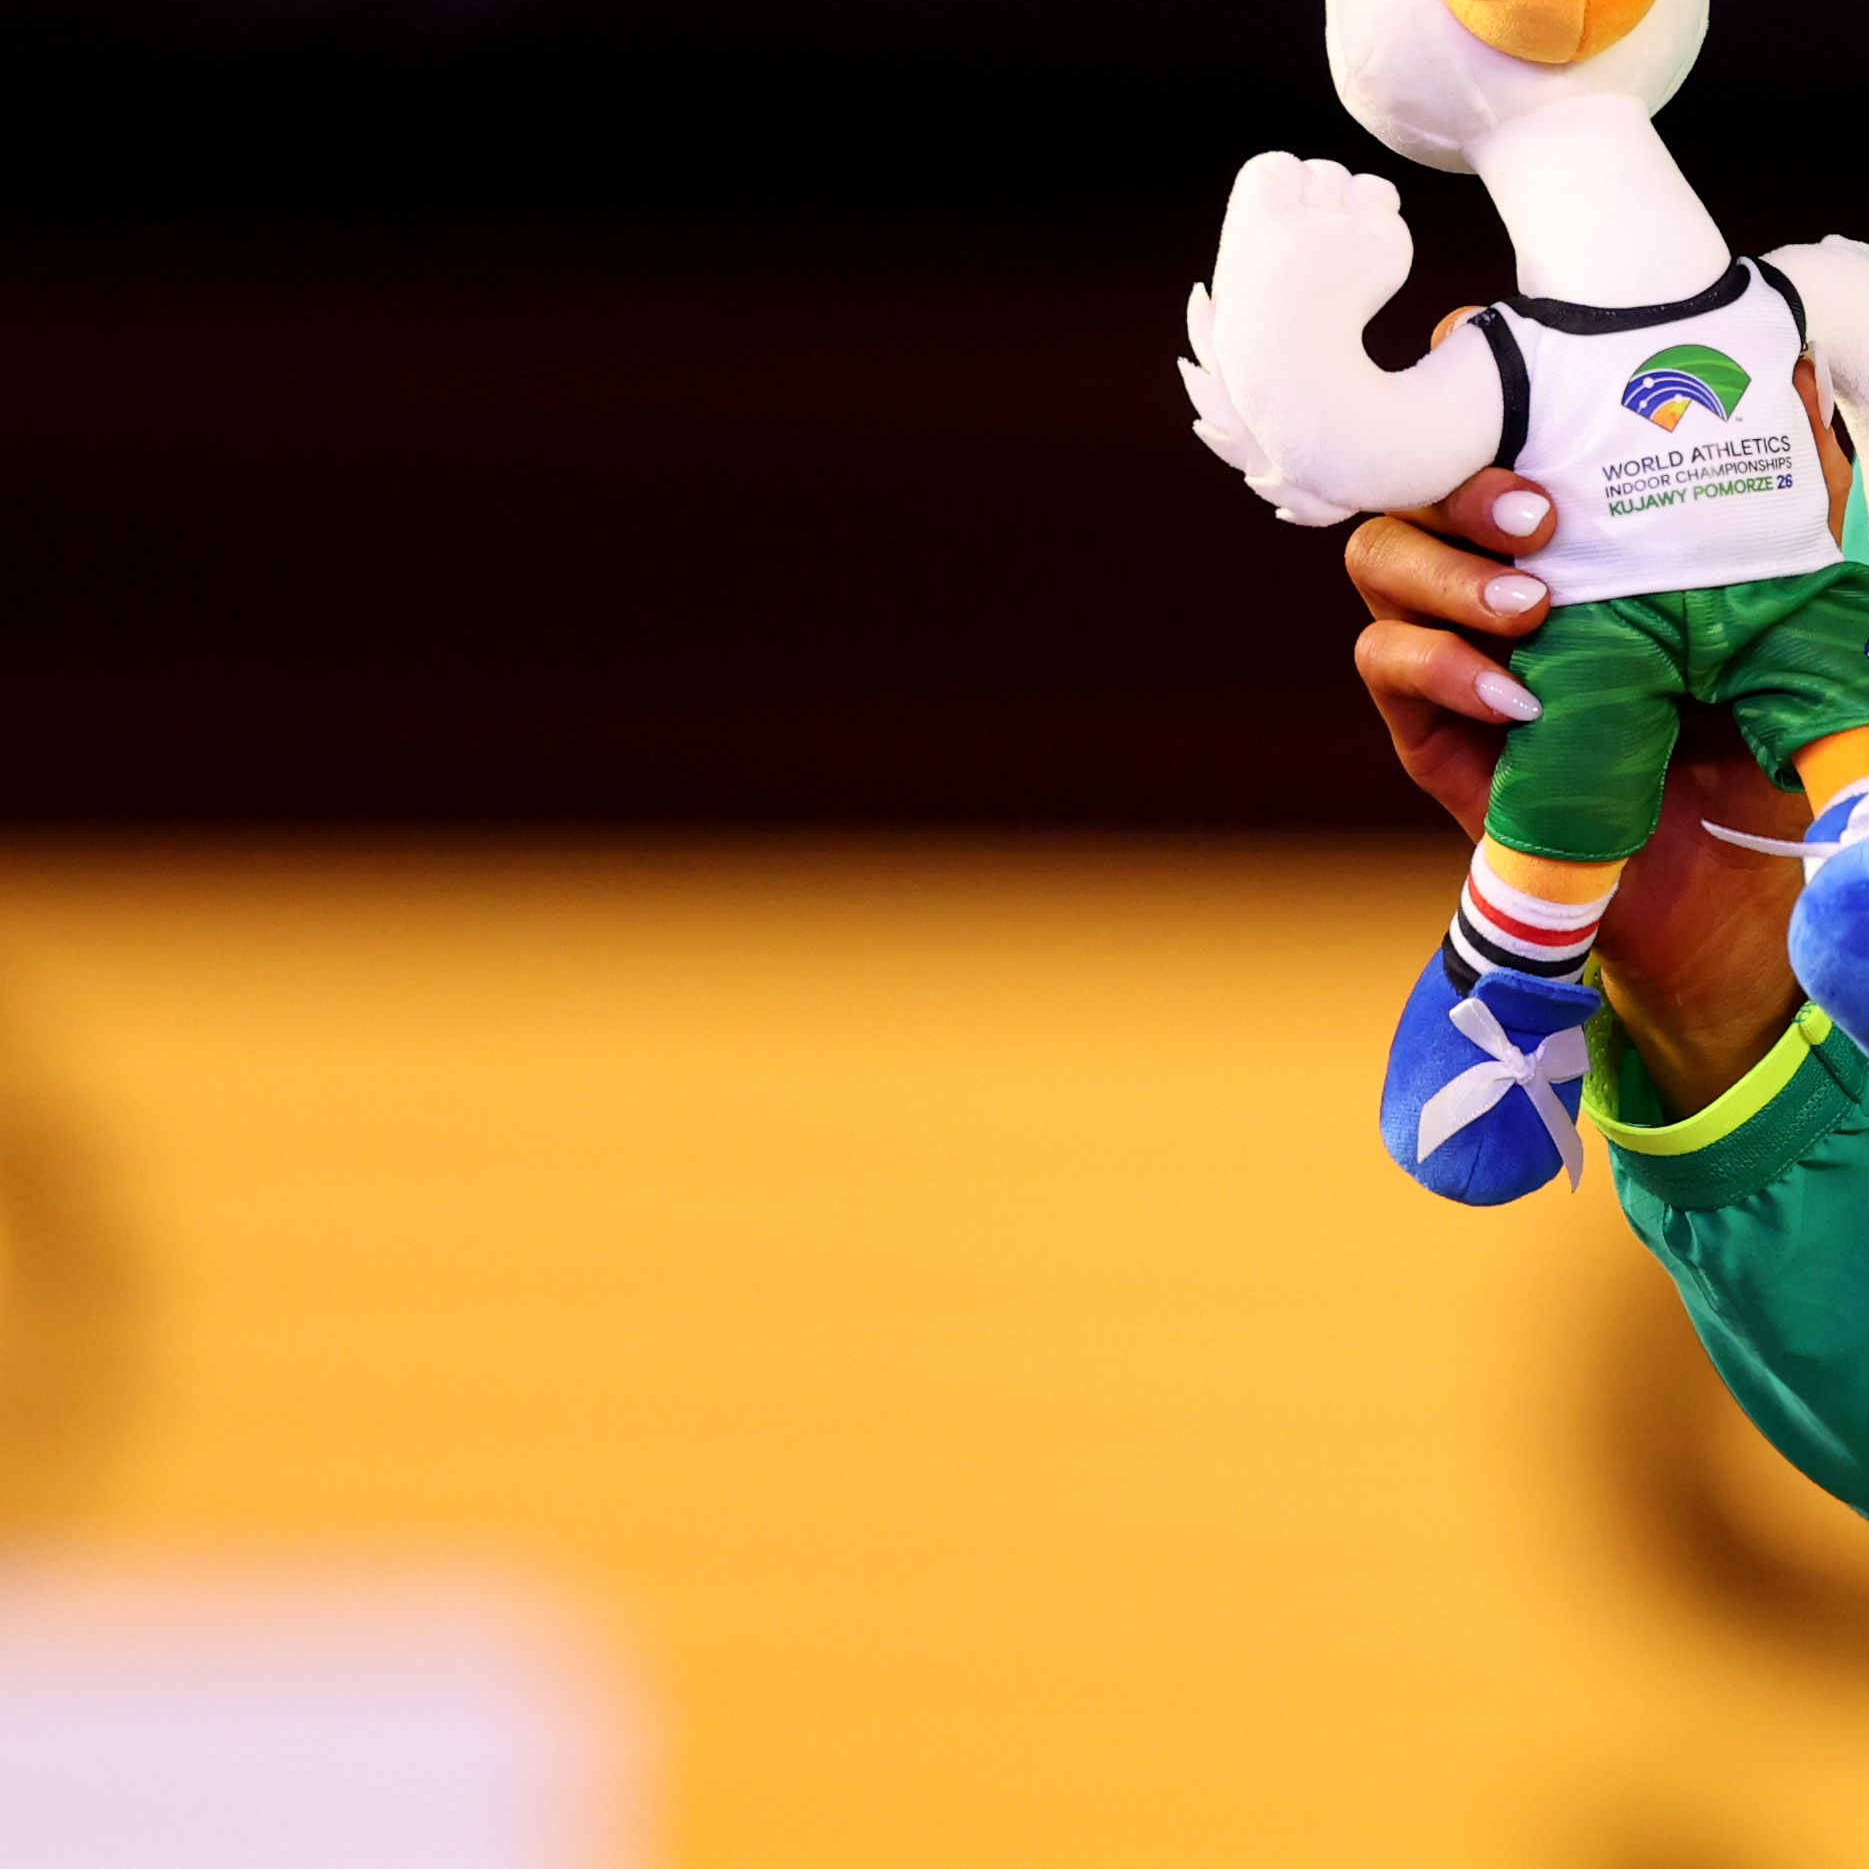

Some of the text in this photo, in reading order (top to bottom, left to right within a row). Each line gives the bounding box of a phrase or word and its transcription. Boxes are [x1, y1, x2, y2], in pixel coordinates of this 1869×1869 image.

[1602, 435, 1791, 481] WORLD ATHLETICS
[1605, 457, 1792, 498] INDOOR CHAMPIONSHIPS
[1608, 473, 1793, 517] KUJAWY POMORZE 26
